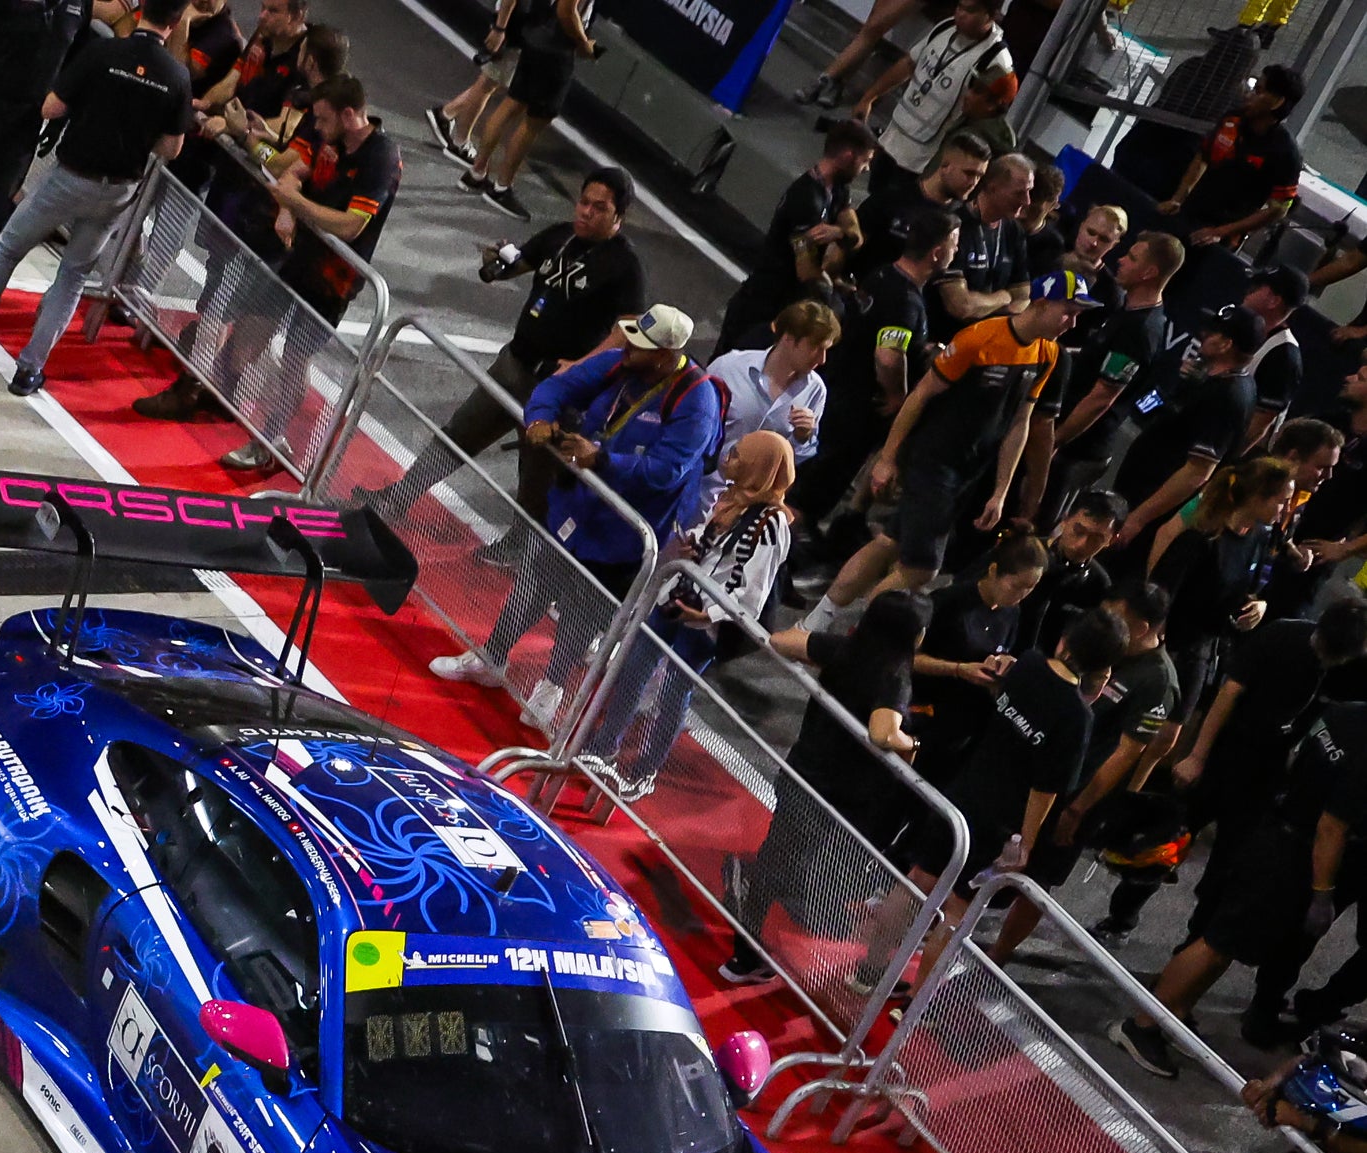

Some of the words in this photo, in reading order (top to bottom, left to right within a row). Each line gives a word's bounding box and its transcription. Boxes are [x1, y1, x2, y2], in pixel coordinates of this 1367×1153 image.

[261, 793, 291, 822] HARTOG
[427, 953, 499, 965] MICHELIN
[504, 947, 549, 973] 12H
[554, 951, 656, 984] MALAYSIA
